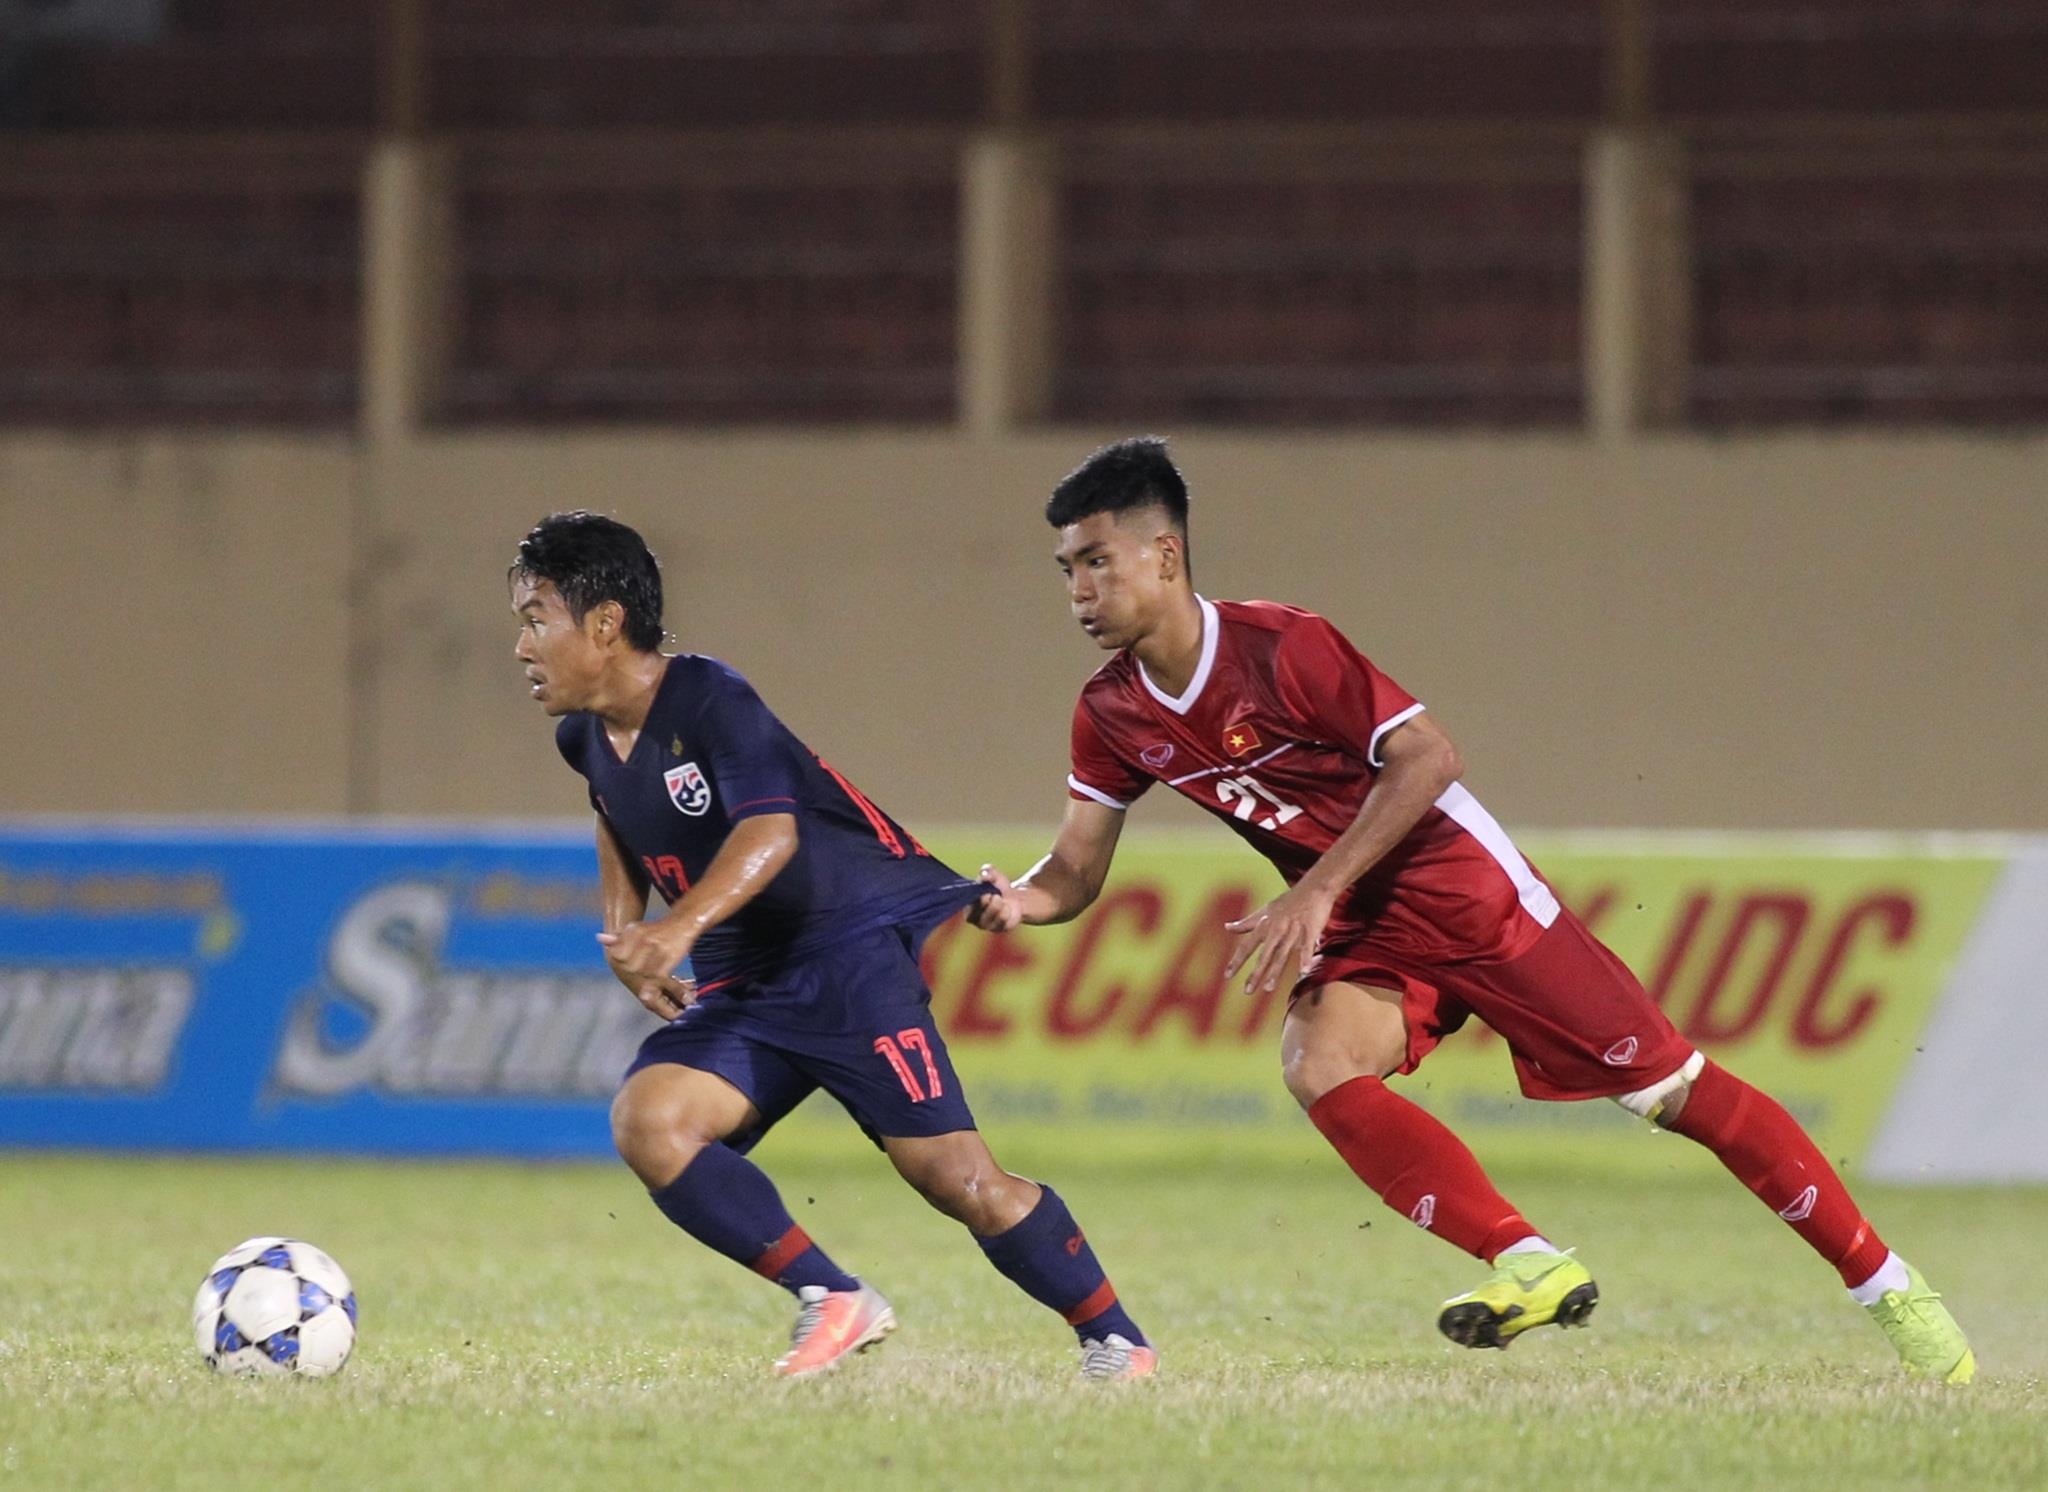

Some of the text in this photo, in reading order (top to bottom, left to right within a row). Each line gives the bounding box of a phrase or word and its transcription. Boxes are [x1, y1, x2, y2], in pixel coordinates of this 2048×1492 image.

[1214, 775, 1304, 831] 21
[1646, 882, 1920, 1052] IDC
[873, 1028, 943, 1103] 17
